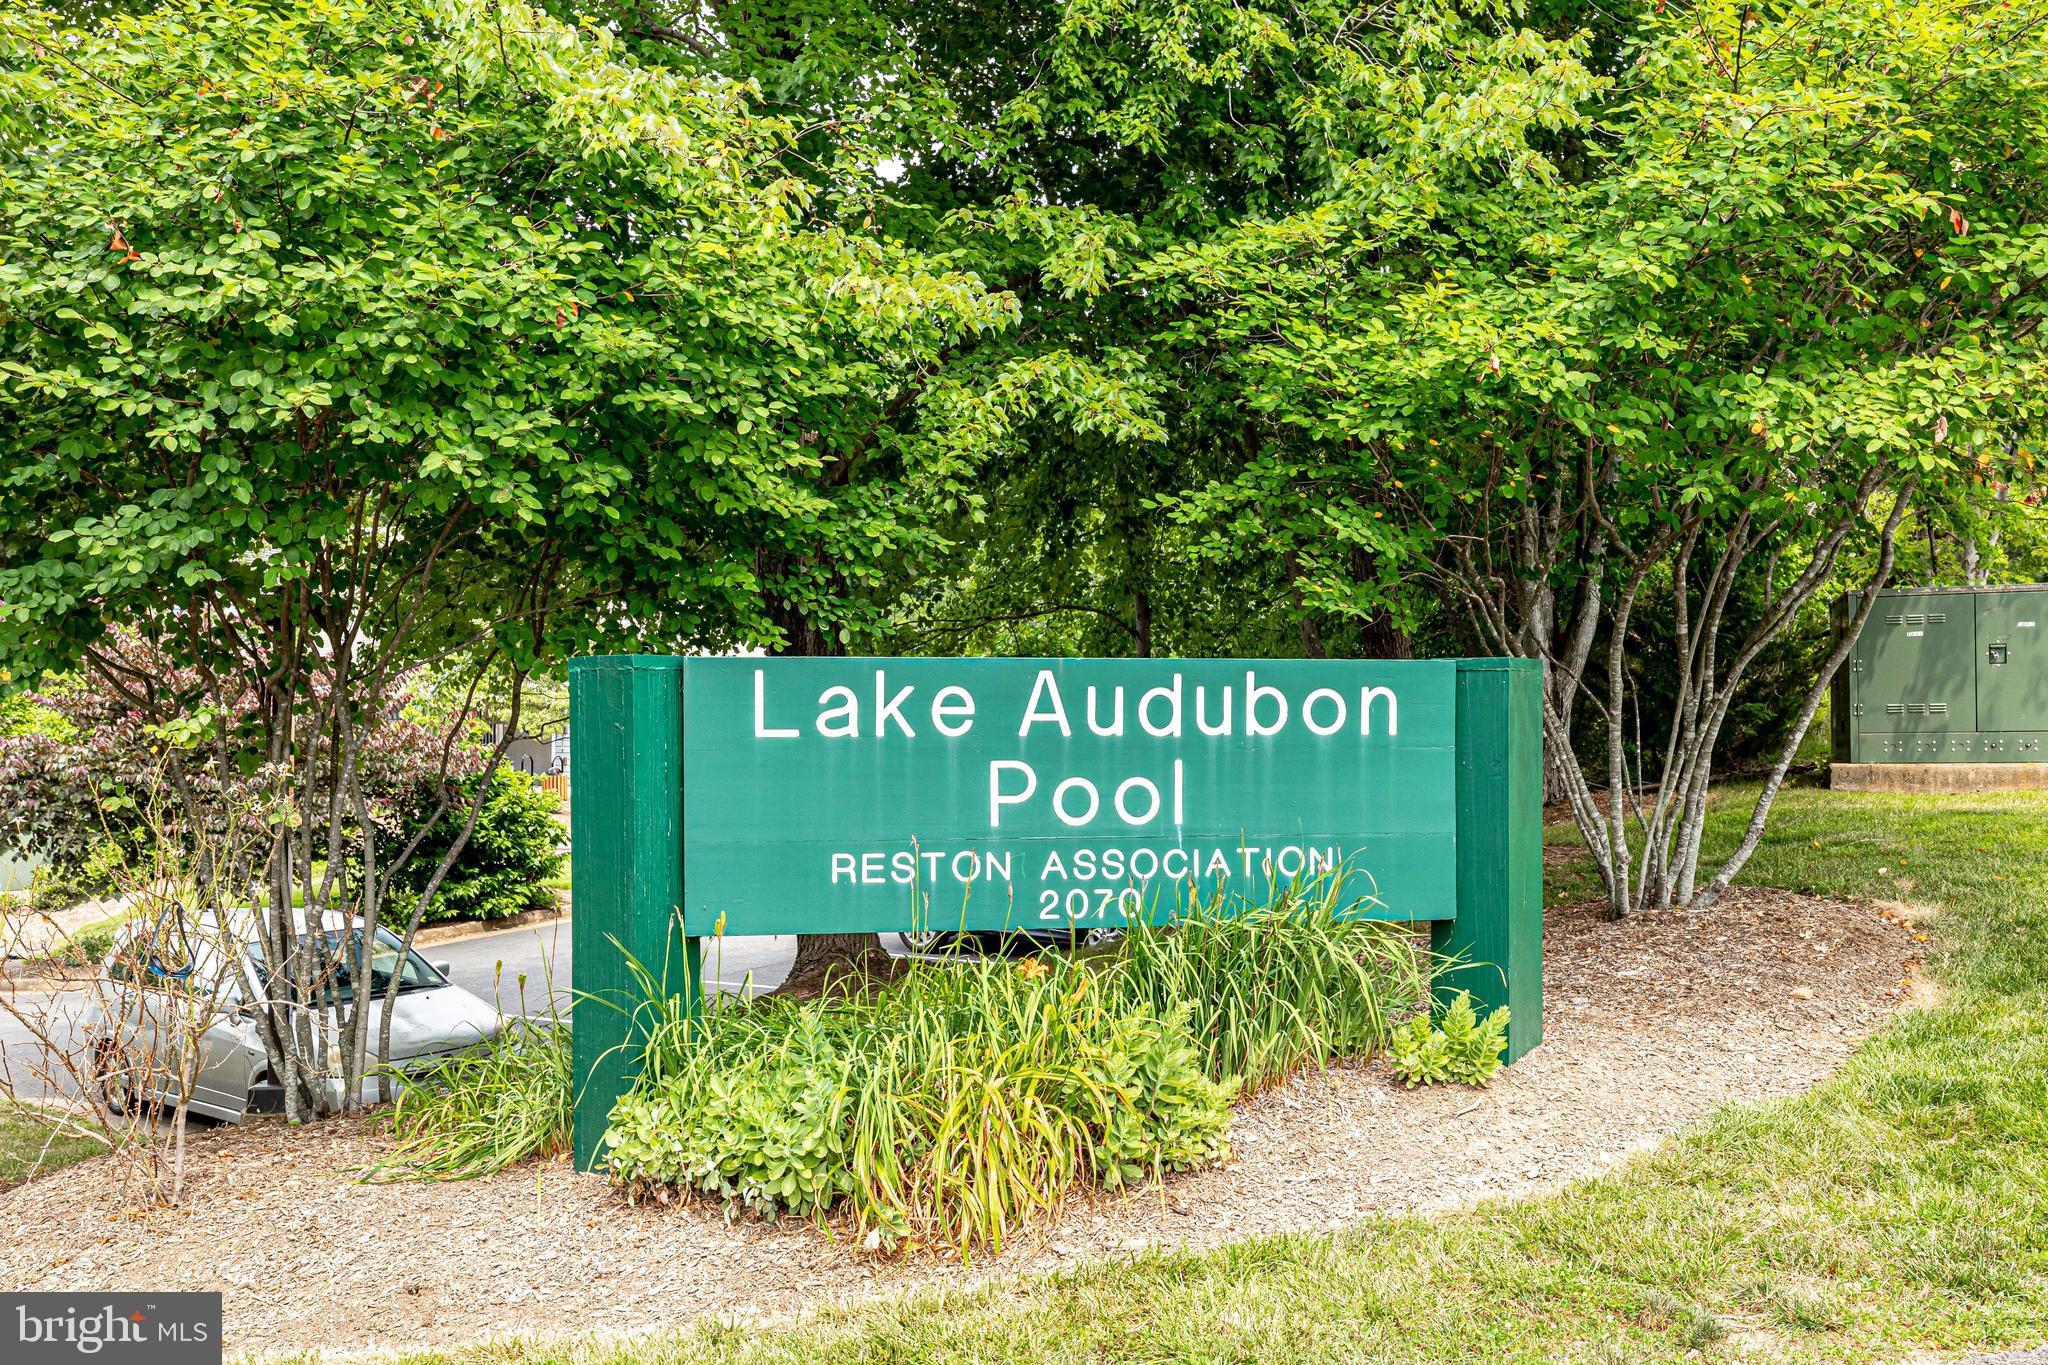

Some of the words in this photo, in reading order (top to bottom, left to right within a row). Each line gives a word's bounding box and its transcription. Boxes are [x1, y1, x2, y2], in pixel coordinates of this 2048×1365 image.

[753, 669, 977, 739] Lake
[1018, 670, 1399, 738] Audubon
[988, 759, 1184, 828] Pool
[831, 850, 1012, 885] RESTON
[1040, 846, 1334, 882] ASSOCIATION
[1039, 887, 1142, 920] 2070
